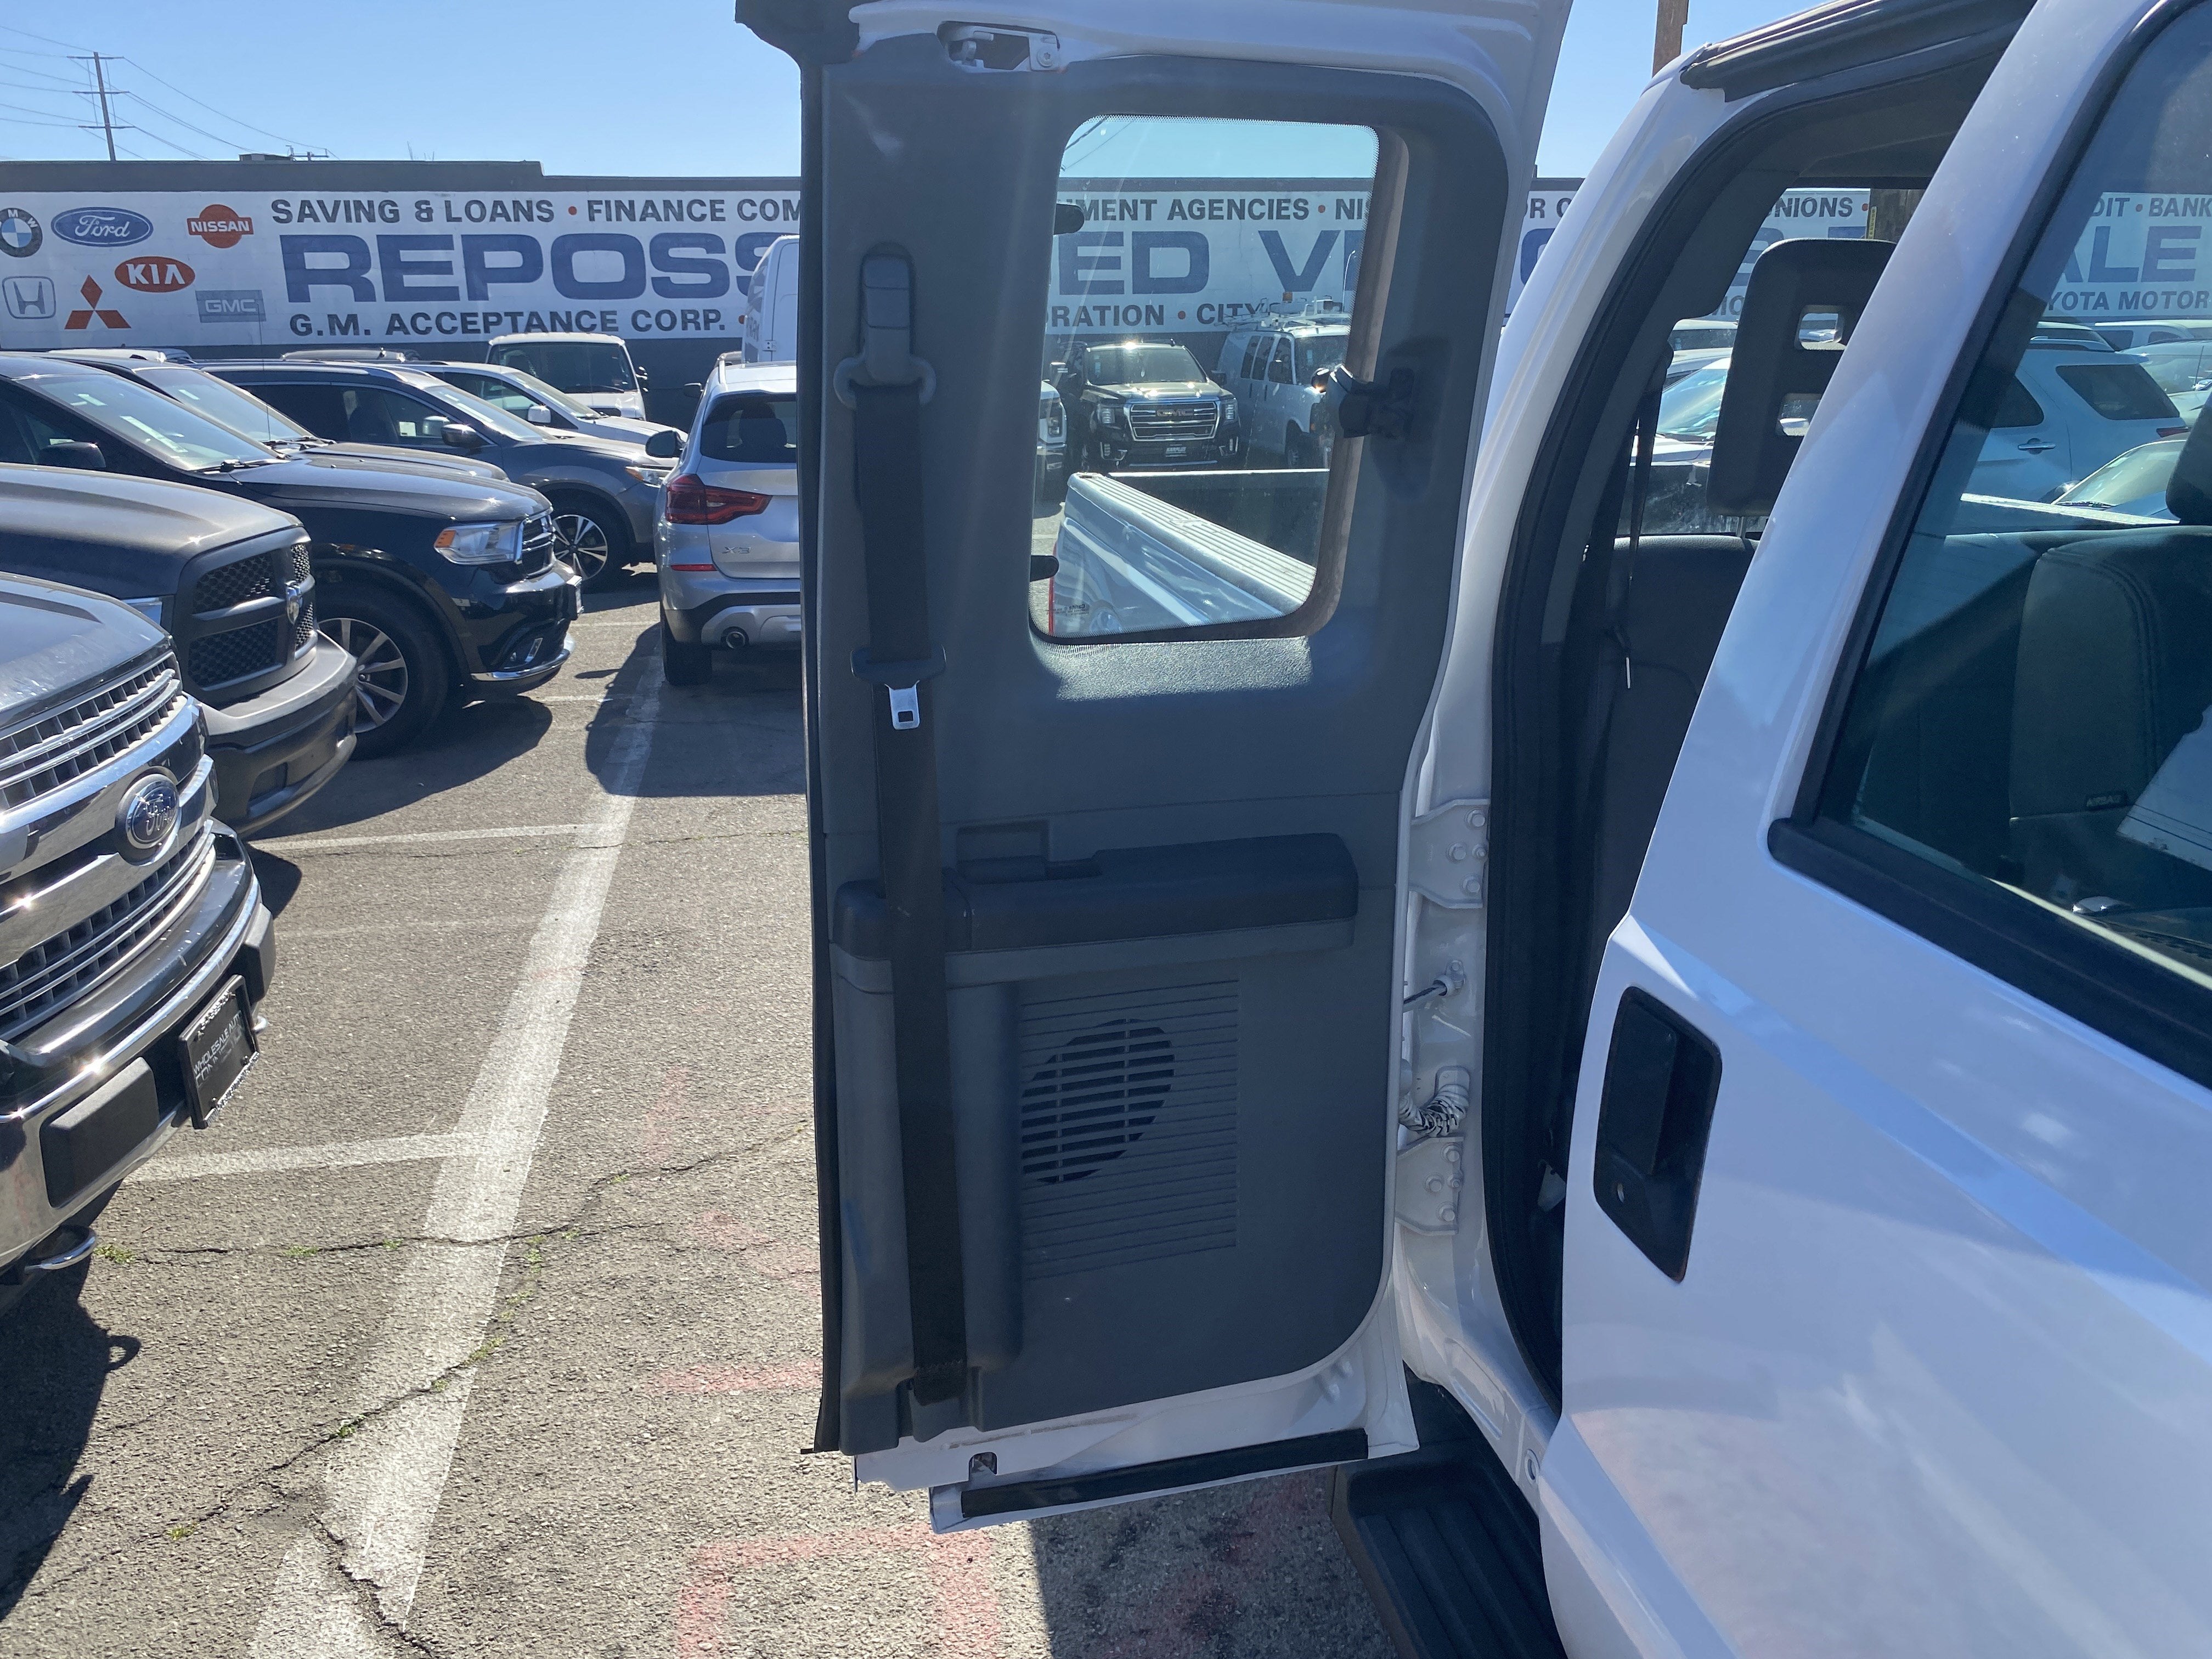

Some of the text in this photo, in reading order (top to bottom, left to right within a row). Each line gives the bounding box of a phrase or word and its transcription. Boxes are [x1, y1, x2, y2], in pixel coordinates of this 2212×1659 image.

[272, 199, 800, 223] SAVING & LOANS FINANCE COM
[1058, 199, 1158, 221] MENT
[1167, 198, 1309, 221] AGENCIES
[1767, 197, 1853, 218] NIONS
[2149, 198, 2212, 217] BANK
[75, 215, 130, 238] Ford
[190, 221, 250, 233] NISSAN
[126, 263, 186, 285] KIA
[205, 299, 256, 313] GMC
[2118, 290, 2210, 310] MOTOR
[290, 313, 371, 336] G.M.
[385, 310, 619, 335] ACCEPTANCE
[631, 309, 725, 332] CORP.
[1047, 303, 1265, 328] RATION CITY
[1156, 408, 1193, 417] GMC
[193, 1028, 229, 1075] WHOLESALE
